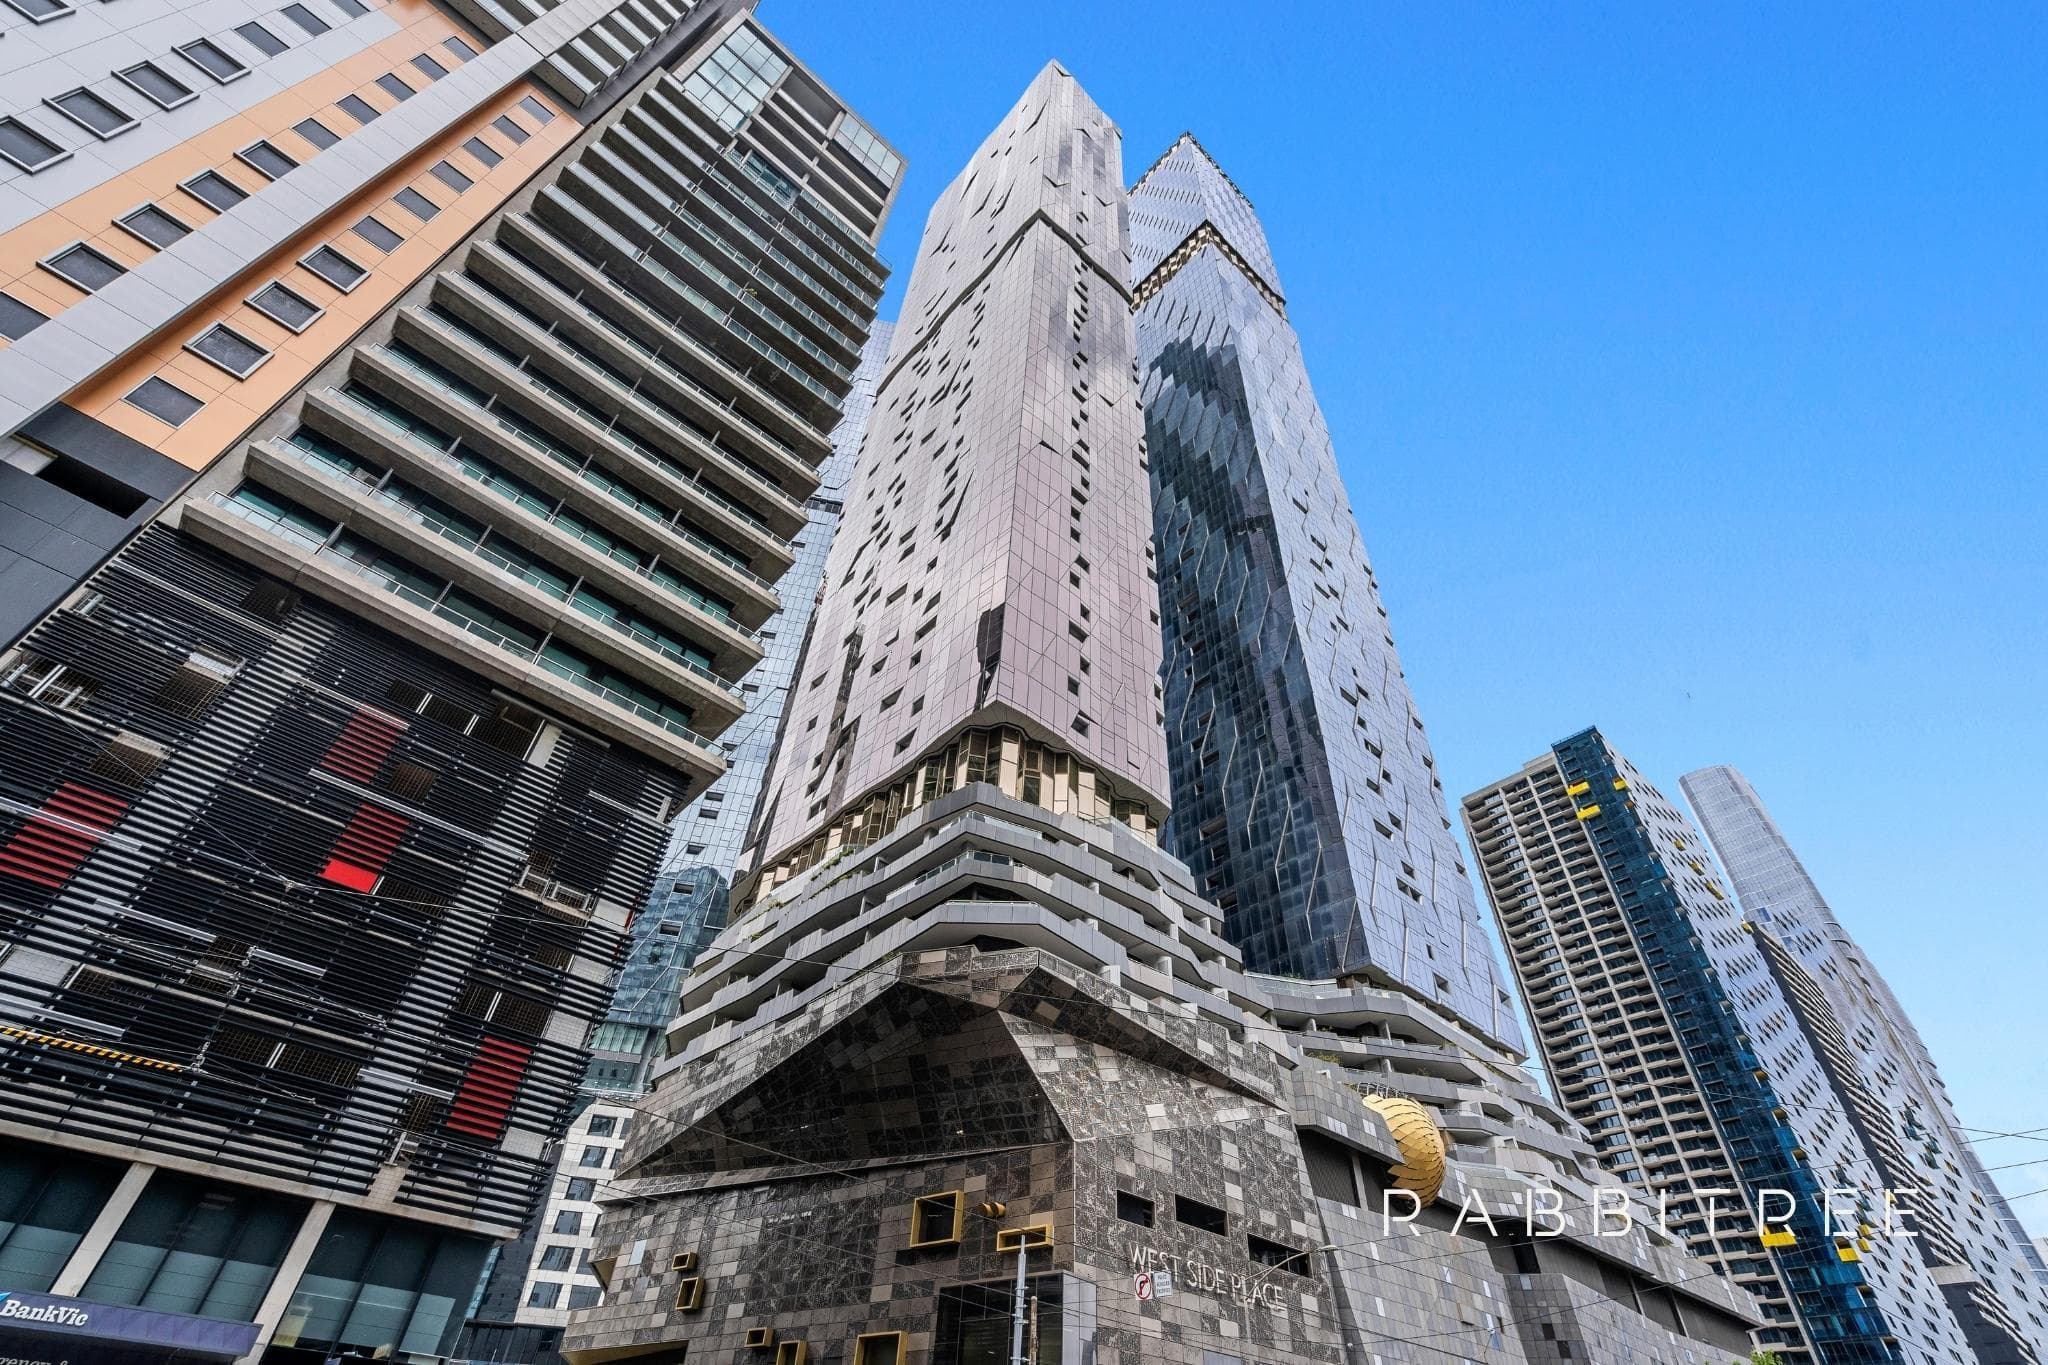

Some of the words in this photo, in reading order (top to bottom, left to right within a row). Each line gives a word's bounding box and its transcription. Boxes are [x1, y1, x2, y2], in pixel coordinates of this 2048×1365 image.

[1129, 1241, 1182, 1283] WEST
[1187, 1260, 1227, 1294] SIDE
[0, 1299, 89, 1326] BankVic
